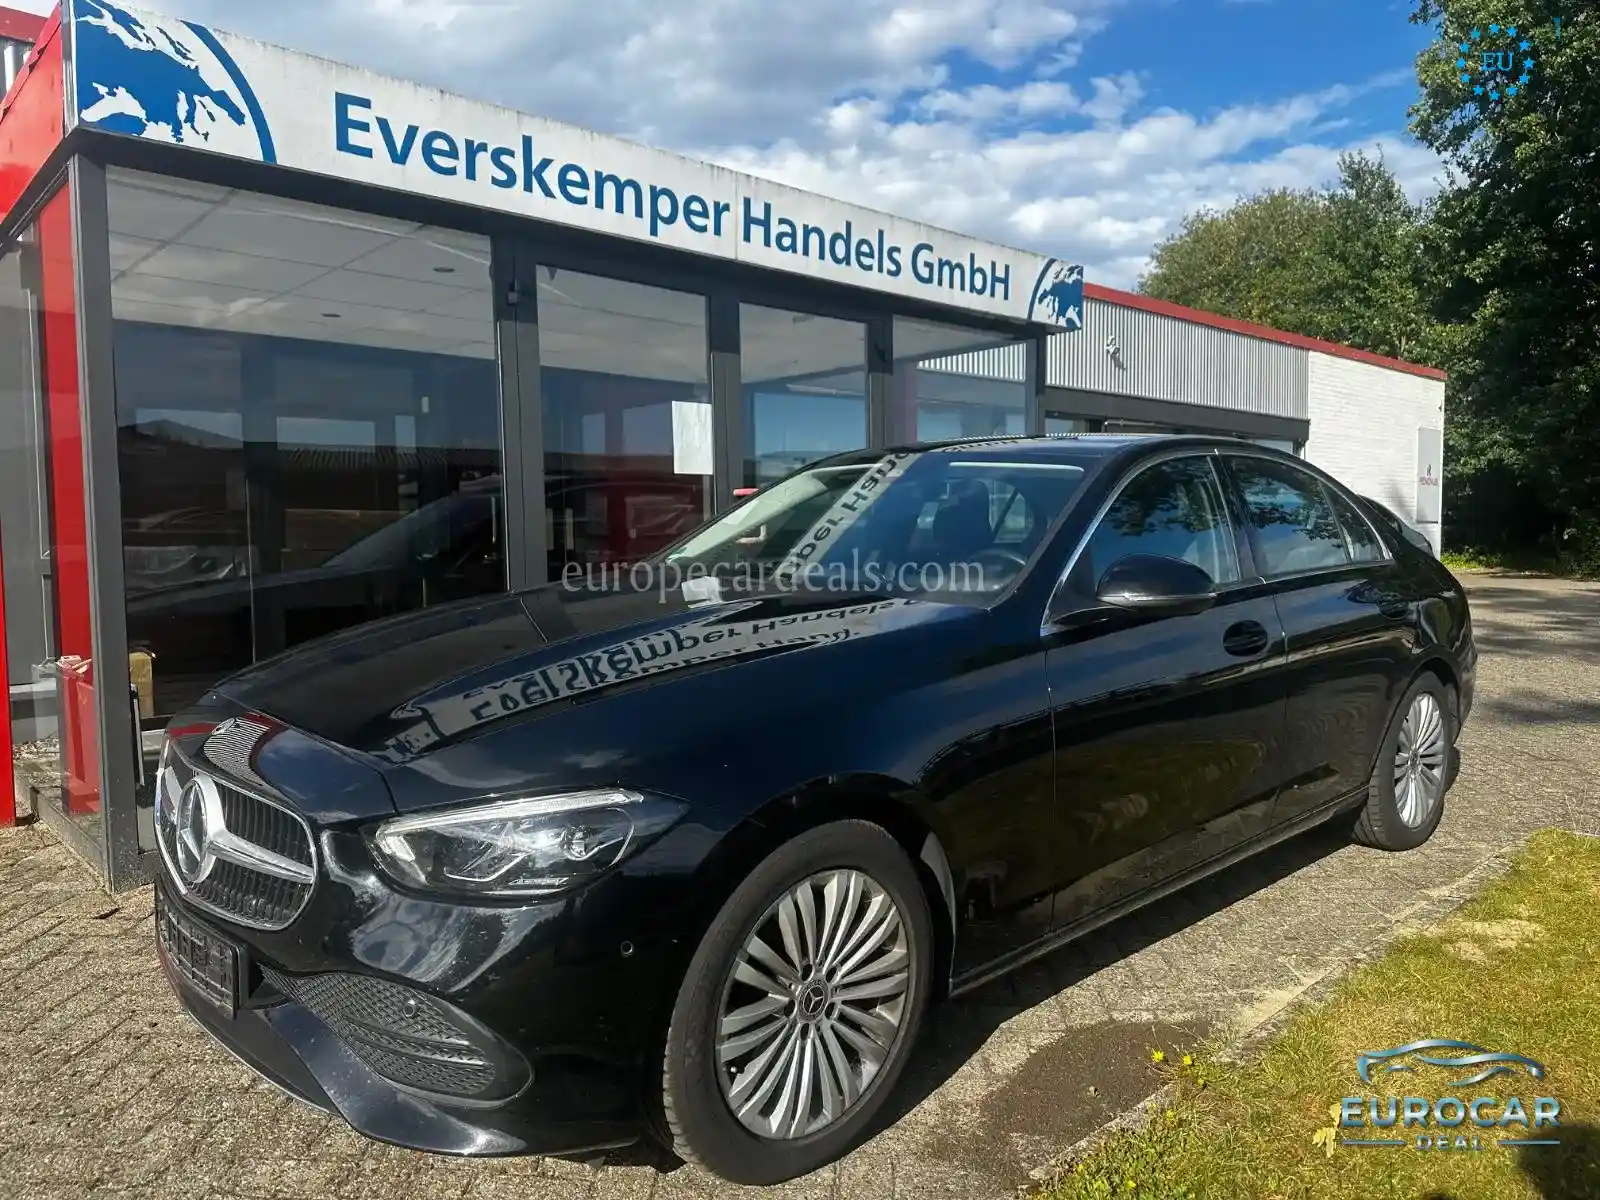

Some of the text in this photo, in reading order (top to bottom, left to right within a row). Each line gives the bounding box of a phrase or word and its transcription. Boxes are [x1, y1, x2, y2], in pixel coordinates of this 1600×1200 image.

[334, 92, 1010, 300] Everskemper Handels GmbH
